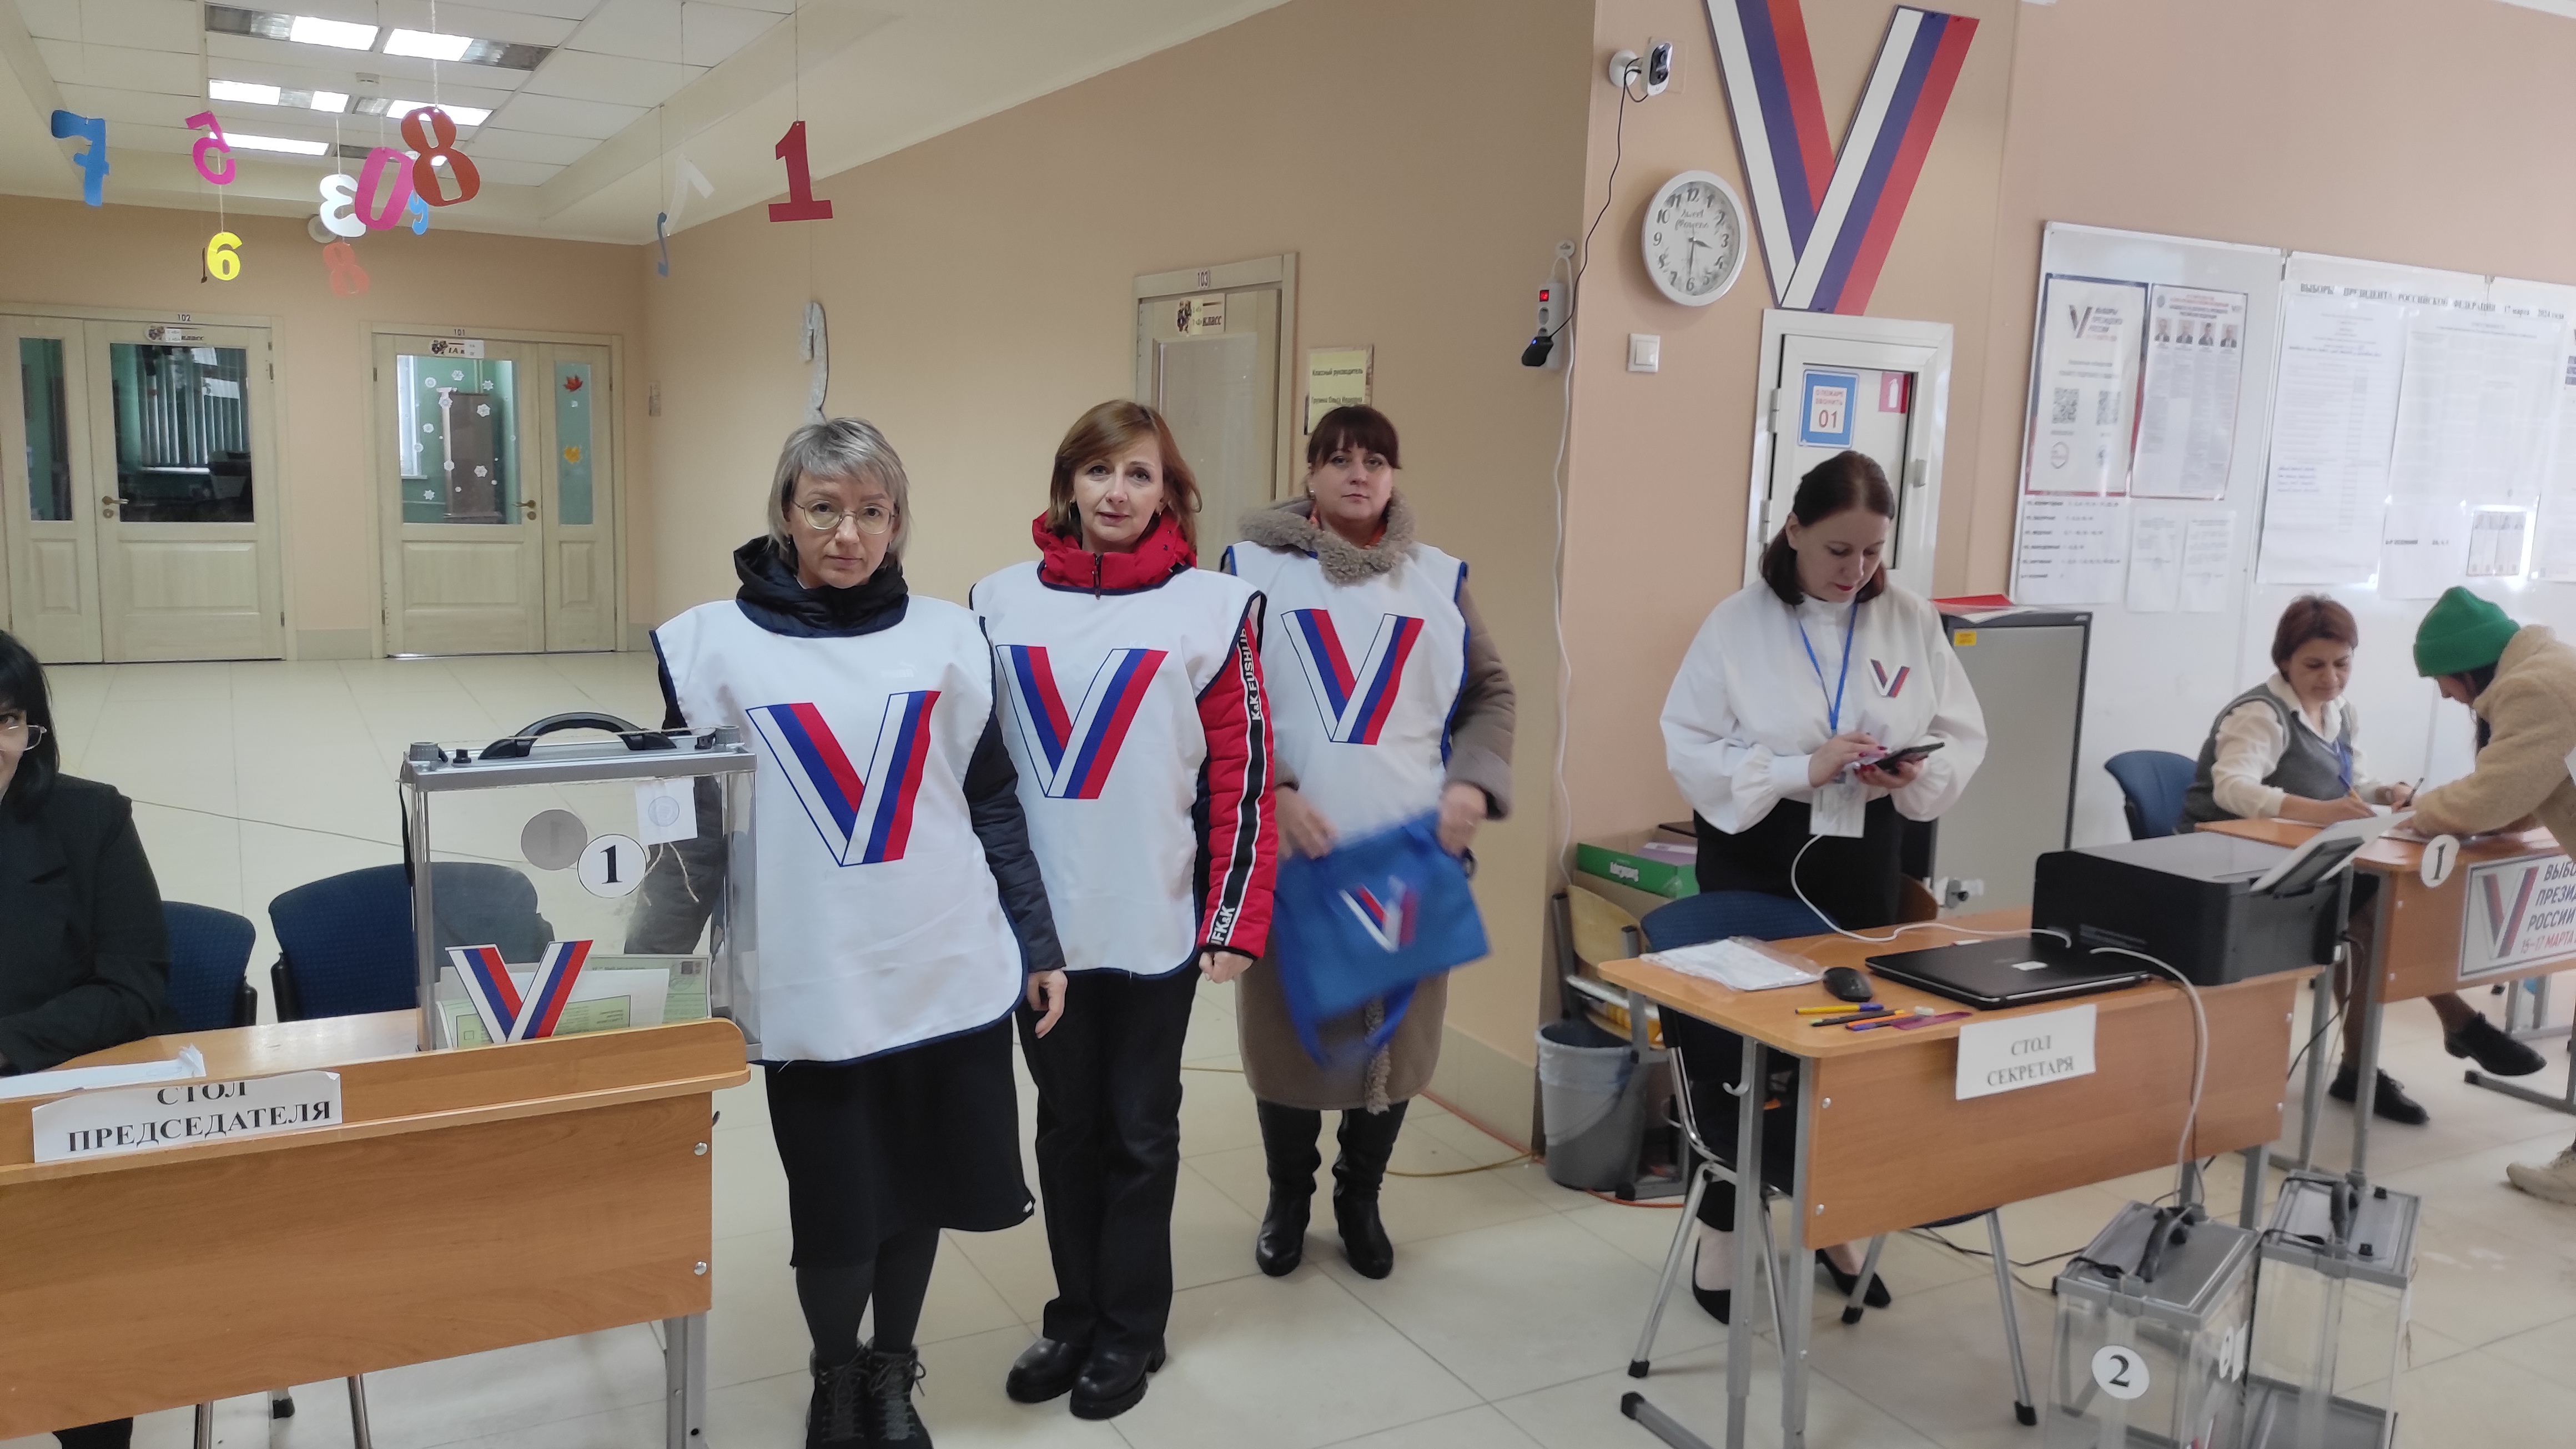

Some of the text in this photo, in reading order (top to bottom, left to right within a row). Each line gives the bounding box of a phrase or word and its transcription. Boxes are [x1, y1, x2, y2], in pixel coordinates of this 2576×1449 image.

[52, 110, 110, 206] 7
[400, 106, 480, 207] 8
[768, 120, 833, 222] 1
[354, 147, 415, 230] 0
[1687, 188, 1699, 202] 12
[1670, 194, 1682, 208] 11
[1707, 194, 1716, 208] 1
[1657, 209, 1670, 224] 10
[1653, 232, 1662, 246] 9
[1721, 233, 1729, 248] 3
[208, 232, 242, 280] 6
[1198, 270, 1208, 287] 103
[1671, 271, 1678, 286] 7
[1686, 278, 1695, 291] 6
[1703, 271, 1712, 285] 5
[177, 314, 191, 322] 102
[1819, 410, 1838, 429] 01
[600, 844, 623, 884] 1
[2433, 843, 2446, 880] 1
[2527, 906, 2576, 933] РОССИИ
[2545, 930, 2575, 949] МАРТА
[2011, 1034, 2051, 1055] СТОЛ
[1987, 1055, 2074, 1086] СЕКРЕТАРЯ
[157, 1080, 246, 1106] СТОЛ
[67, 1100, 331, 1153] ПРЕДСЕДАТЕЛЯ
[2109, 1354, 2130, 1388] 2
